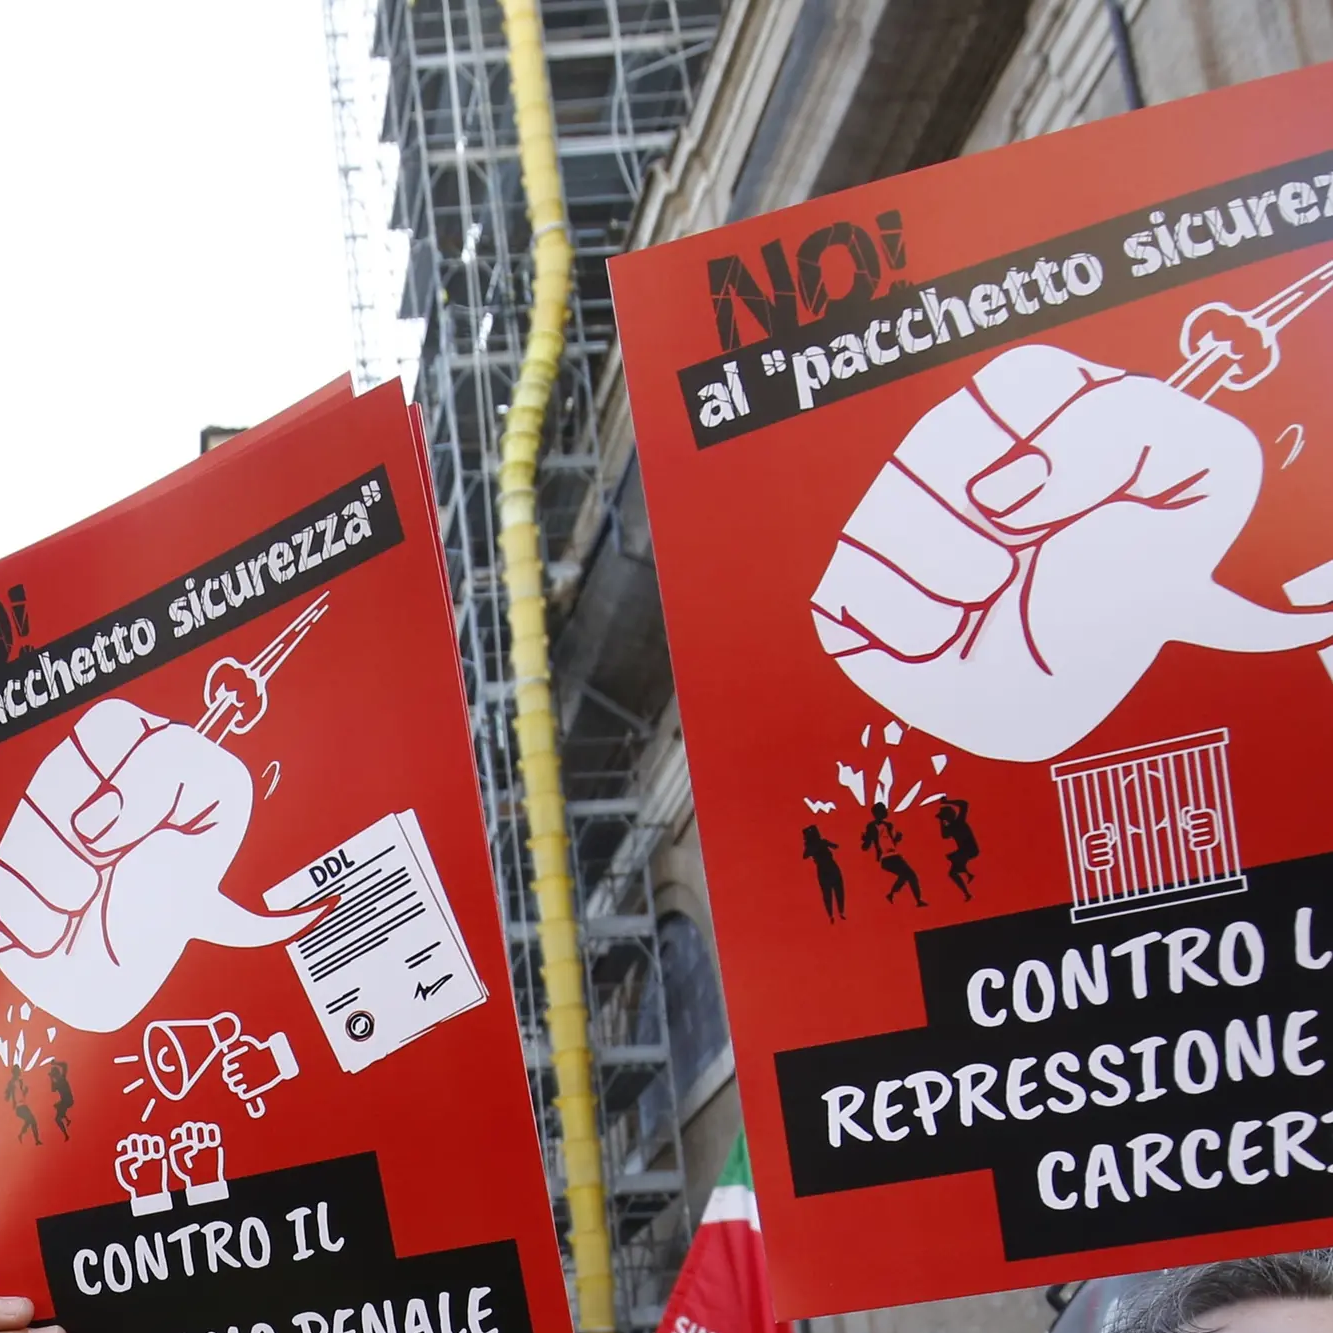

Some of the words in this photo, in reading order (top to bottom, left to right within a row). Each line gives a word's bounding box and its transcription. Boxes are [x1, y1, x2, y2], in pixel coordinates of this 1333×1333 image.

[698, 361, 750, 429] al
[761, 250, 1104, 410] "pacchetto
[707, 210, 909, 353] NO!
[169, 480, 382, 639] sicurezza"
[309, 848, 356, 888] DDL
[966, 920, 1266, 1028] CONTRO
[821, 1010, 1326, 1148] REPRESSIONE
[1037, 1111, 1333, 1212] CARCER
[73, 1216, 269, 1296] CONTRO
[285, 1202, 345, 1261] IL
